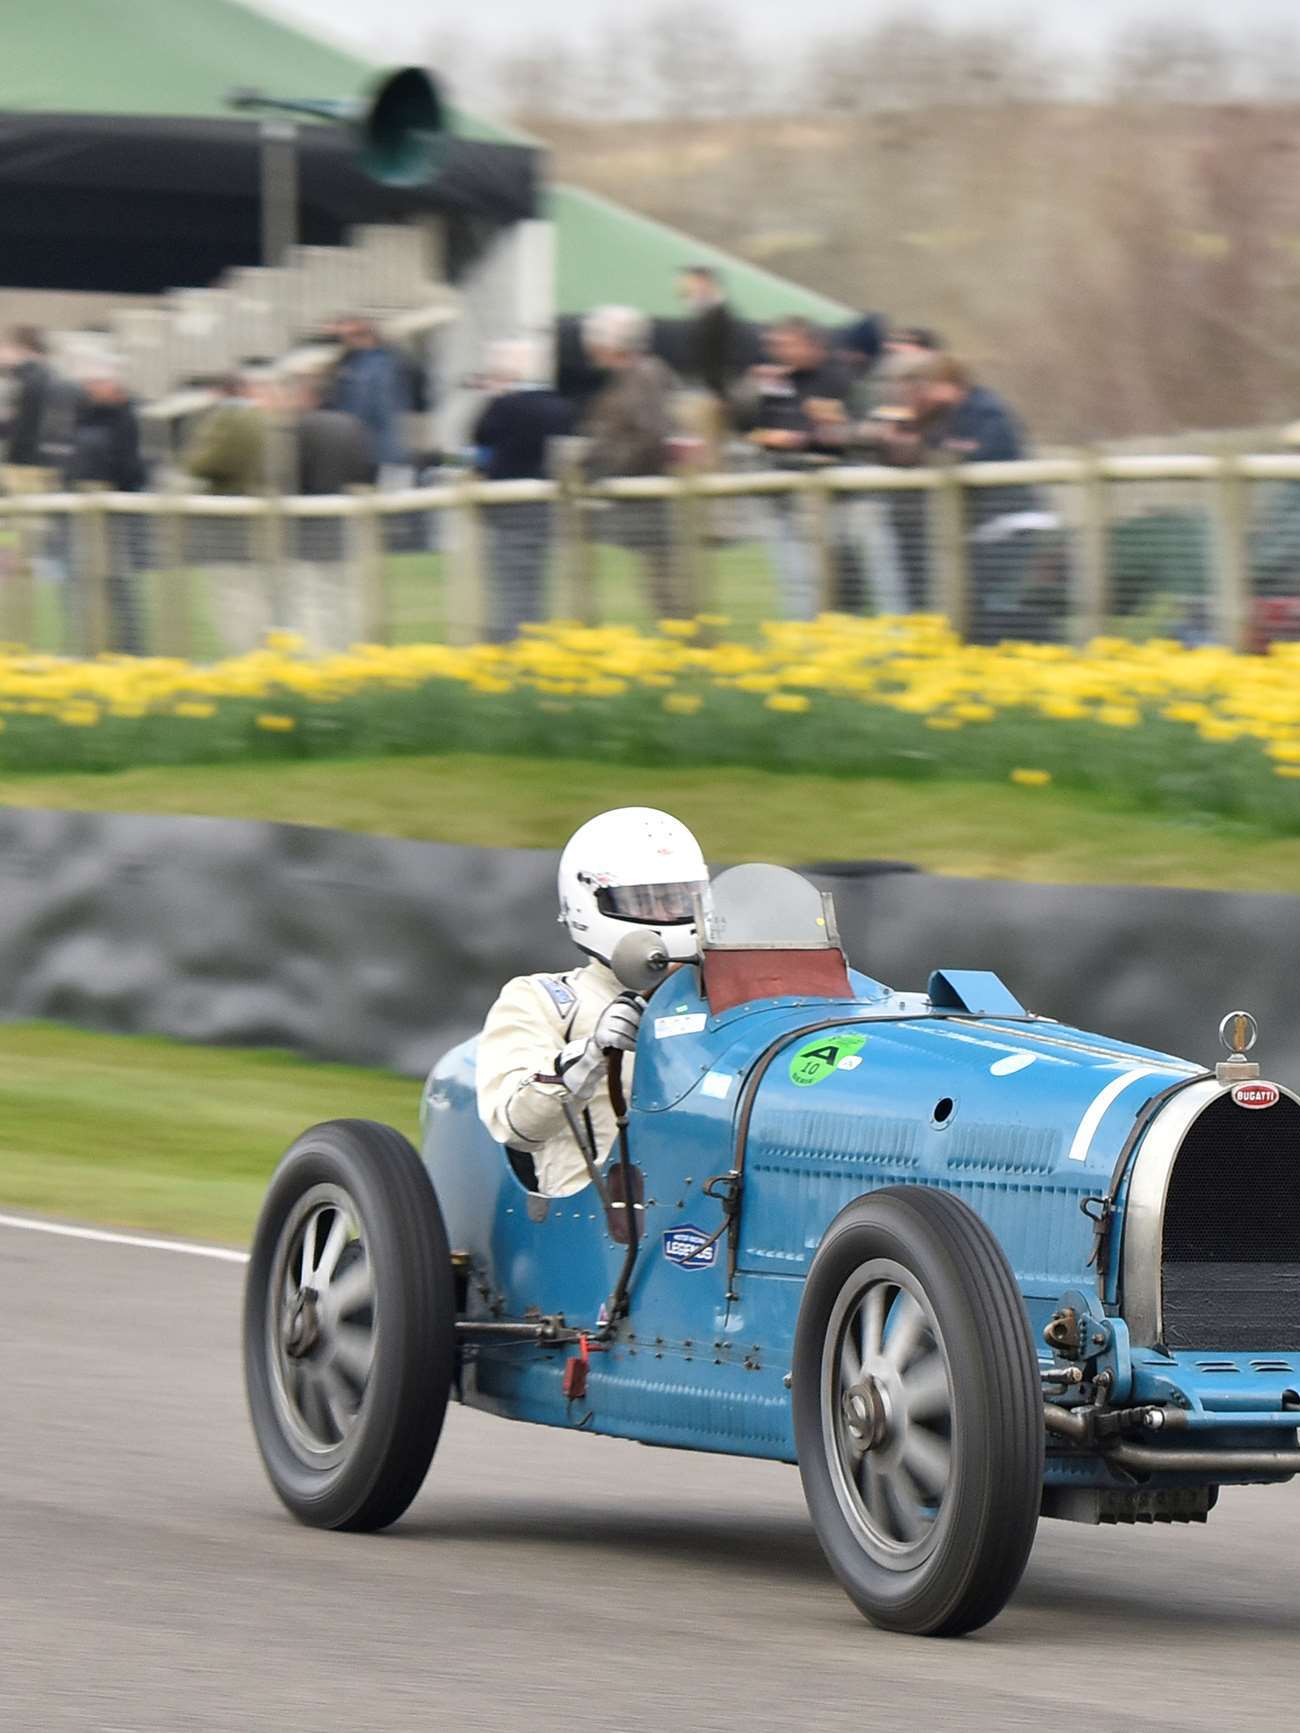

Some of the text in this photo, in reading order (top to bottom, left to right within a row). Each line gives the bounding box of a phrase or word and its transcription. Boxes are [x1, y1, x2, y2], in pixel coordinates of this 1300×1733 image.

[800, 1045, 840, 1067] A
[800, 1062, 820, 1075] 10
[1237, 1091, 1274, 1100] BUGATTI
